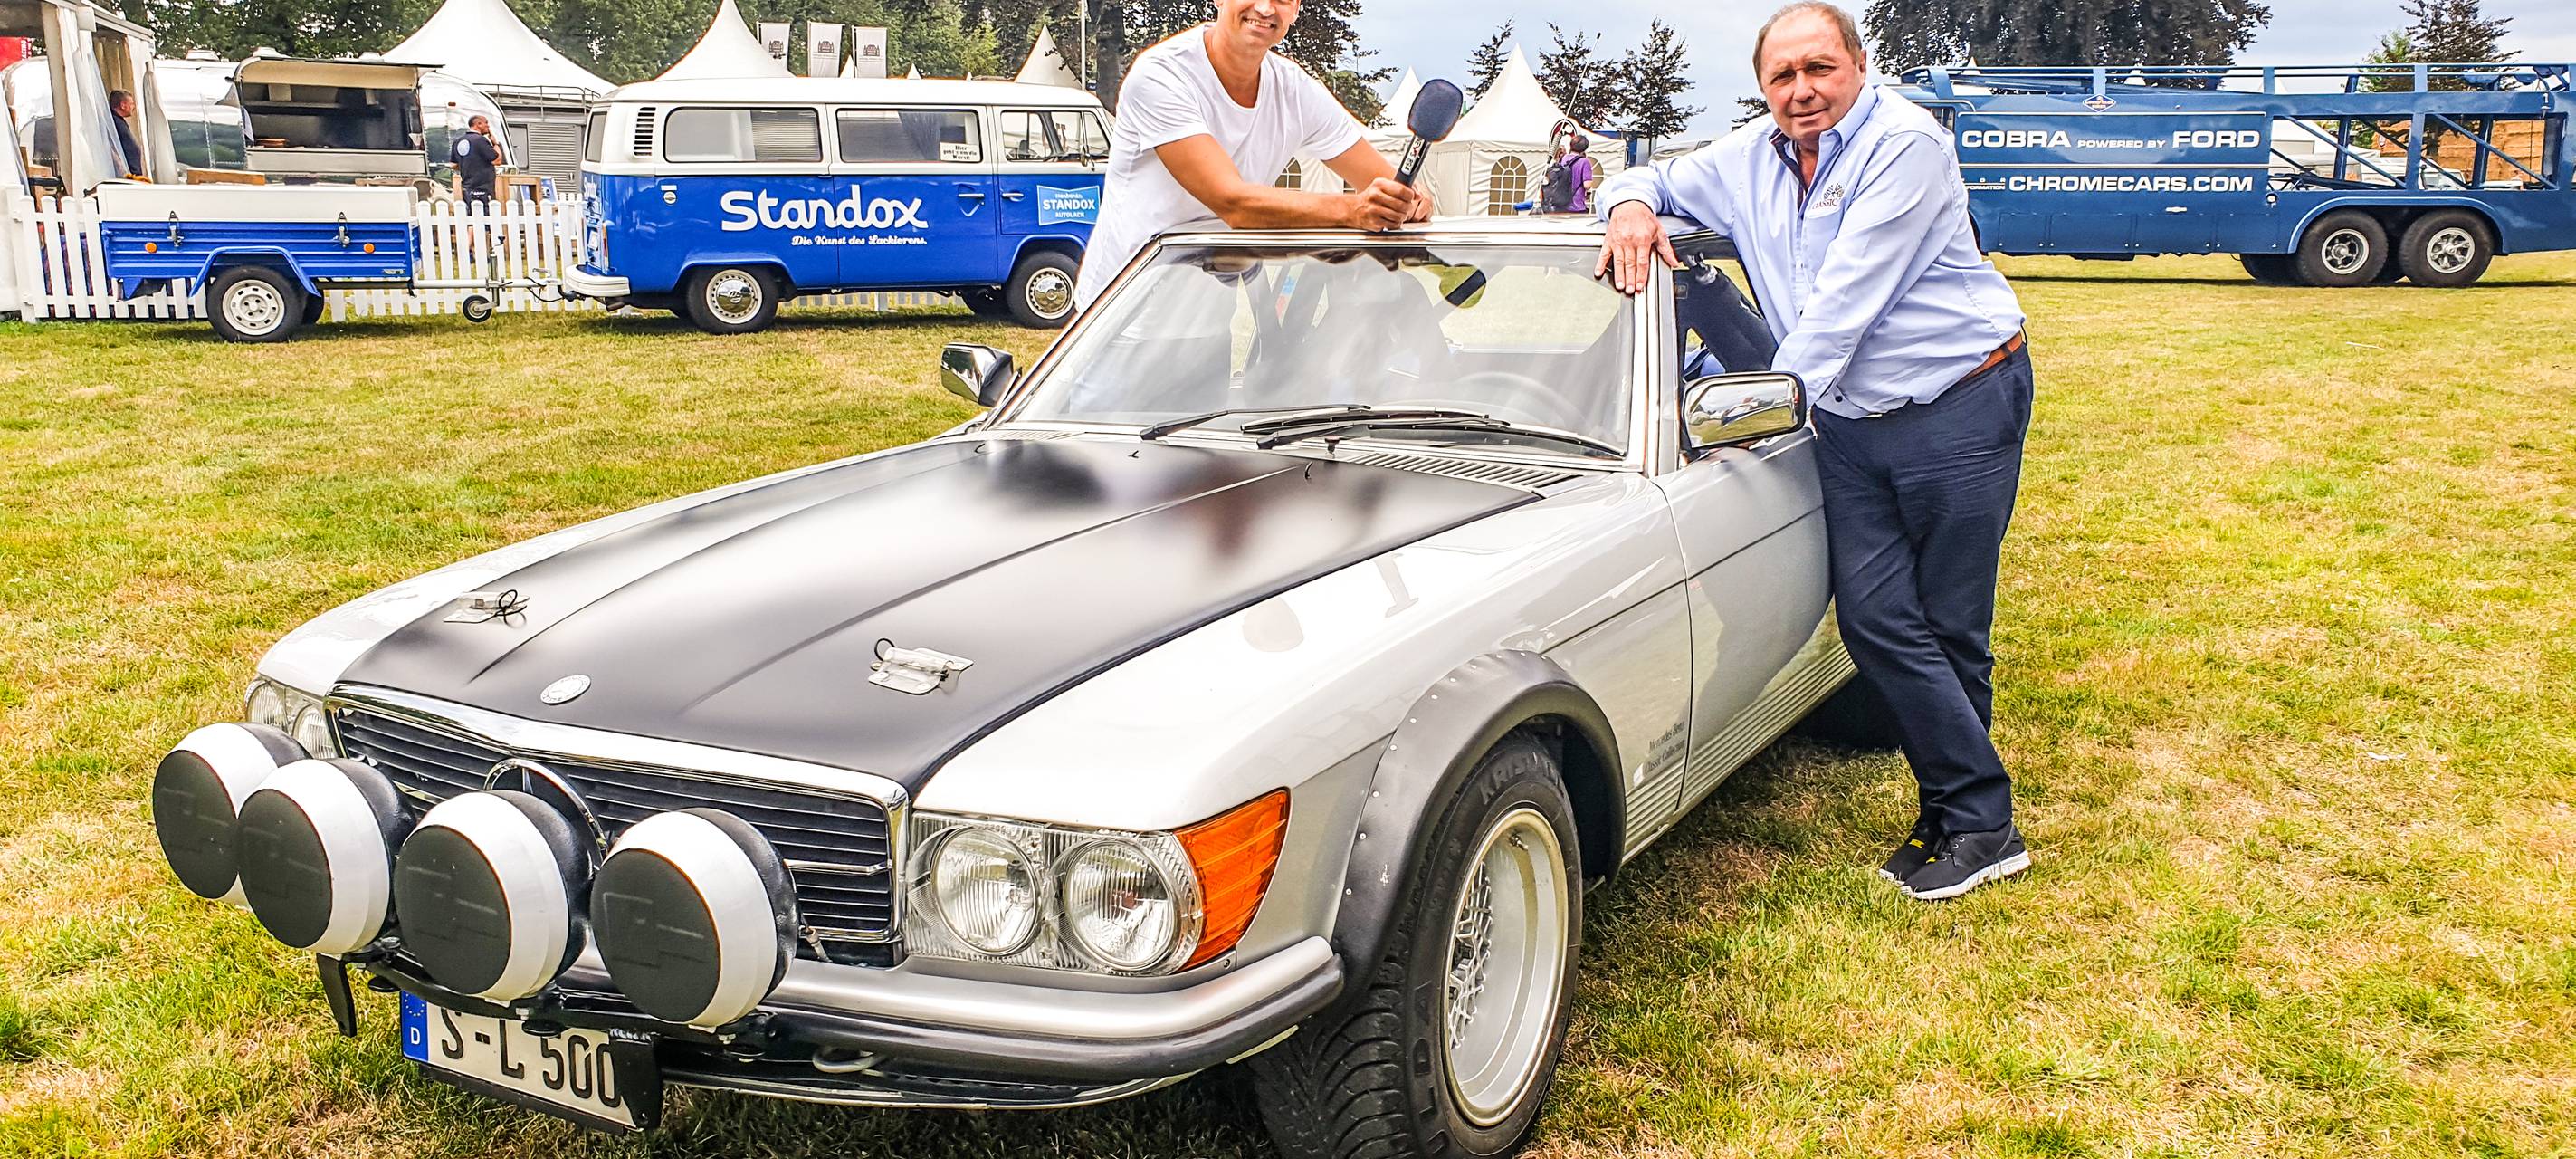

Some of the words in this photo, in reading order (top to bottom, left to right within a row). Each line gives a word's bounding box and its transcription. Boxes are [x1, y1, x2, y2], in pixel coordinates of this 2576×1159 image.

[1961, 130, 2072, 148] COBRA
[2077, 139, 2143, 148] POWERED
[2147, 139, 2166, 148] BY
[2172, 130, 2260, 148] FORD
[2008, 176, 2253, 192] CHROMECARS.COM
[720, 184, 929, 231] Standox
[1043, 199, 1096, 211] STANDOX
[791, 235, 813, 246] Die
[815, 235, 846, 245] Kunst
[848, 235, 866, 245] des
[410, 1027, 421, 1045] D
